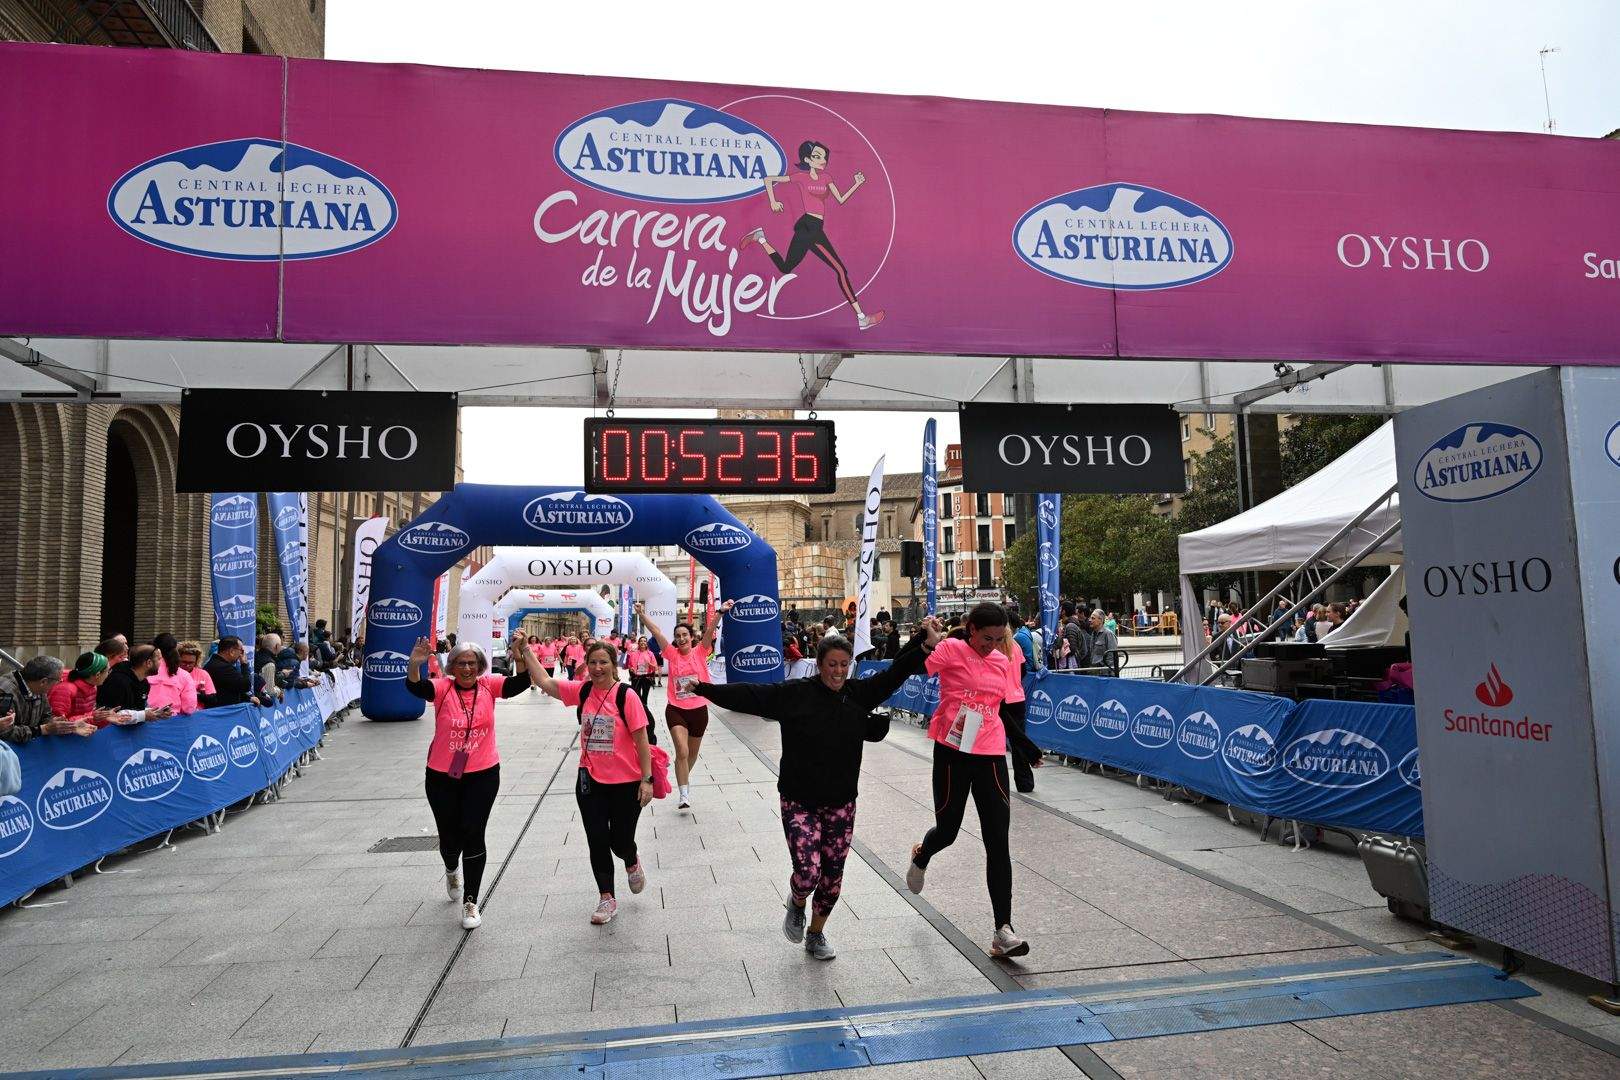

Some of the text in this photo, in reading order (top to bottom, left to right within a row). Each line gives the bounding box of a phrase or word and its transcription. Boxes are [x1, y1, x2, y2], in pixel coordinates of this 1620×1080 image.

[610, 131, 762, 150] CENTRAL LECHERA
[573, 132, 768, 180] ASTURIANA
[178, 178, 367, 196] CENTRAL LECHERA
[130, 180, 376, 232] ASTURIANA
[533, 190, 727, 252] Carrera
[1065, 219, 1209, 232] CENTRAL LECHERA
[1032, 219, 1218, 263] ASTURIANA
[1336, 232, 1490, 273] OYSHO
[1584, 252, 1620, 279] Sa
[582, 247, 798, 337] de la Mujer
[226, 422, 418, 461] OYSHO
[998, 433, 1151, 467] OYSHO
[1439, 440, 1526, 464] CENTRAL LECHERA
[949, 450, 962, 460] TI
[1423, 451, 1532, 489] ASTURIANA
[531, 504, 625, 525] ASTURIANA
[402, 532, 464, 547] ASTURIANA
[690, 535, 747, 546] ASTURIANA
[528, 559, 613, 577] OYSHO
[1423, 557, 1552, 597] OYSHO
[370, 609, 418, 621] ASTURIANA
[732, 606, 777, 617] ASTURIANA
[365, 660, 408, 673] ASTURIAN
[734, 656, 780, 667] ASTURIANA
[451, 718, 464, 728] TU
[1132, 719, 1171, 740] ASTURIANA
[1443, 709, 1552, 742] Santander
[448, 741, 480, 751] SUMA
[1288, 748, 1380, 777] ASTURIANA
[125, 766, 181, 794] ASTURIANA
[45, 787, 110, 822] ASTURIANA
